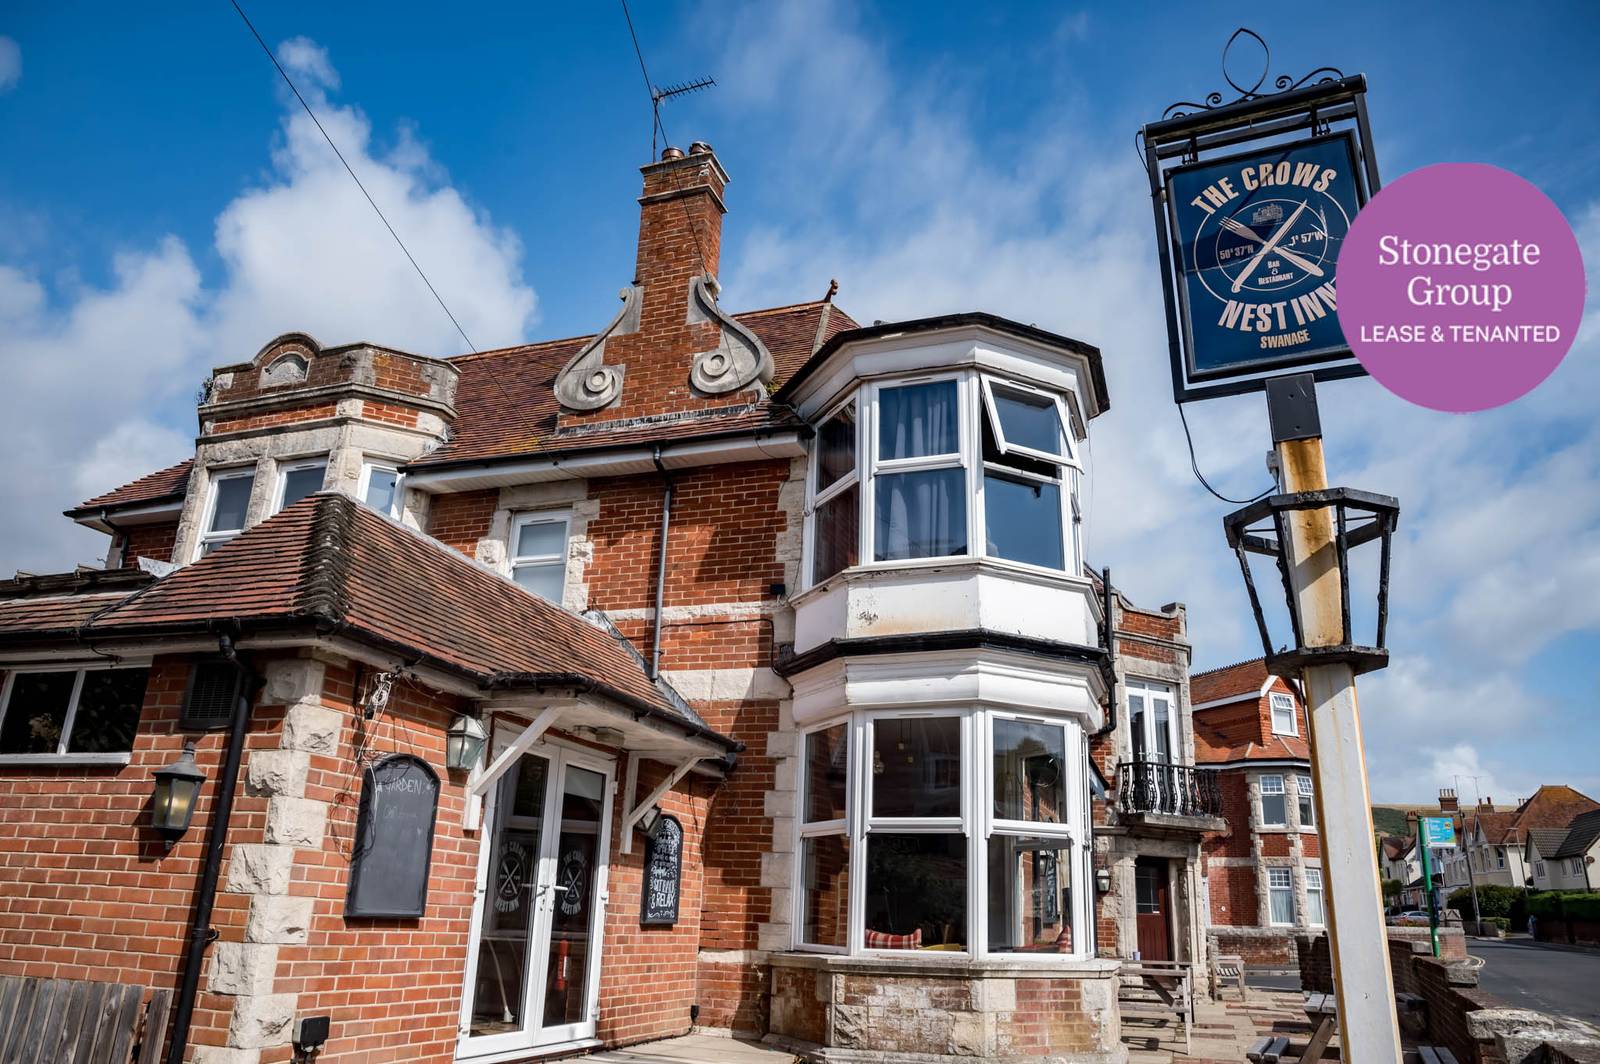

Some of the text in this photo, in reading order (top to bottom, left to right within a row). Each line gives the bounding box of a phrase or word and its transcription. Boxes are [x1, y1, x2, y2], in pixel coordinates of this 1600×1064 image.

[1191, 161, 1337, 215] THE CROWS
[1258, 272, 1294, 286] RESTAURANT
[1218, 281, 1337, 332] NEST INN
[1260, 329, 1311, 349] SWANAGE
